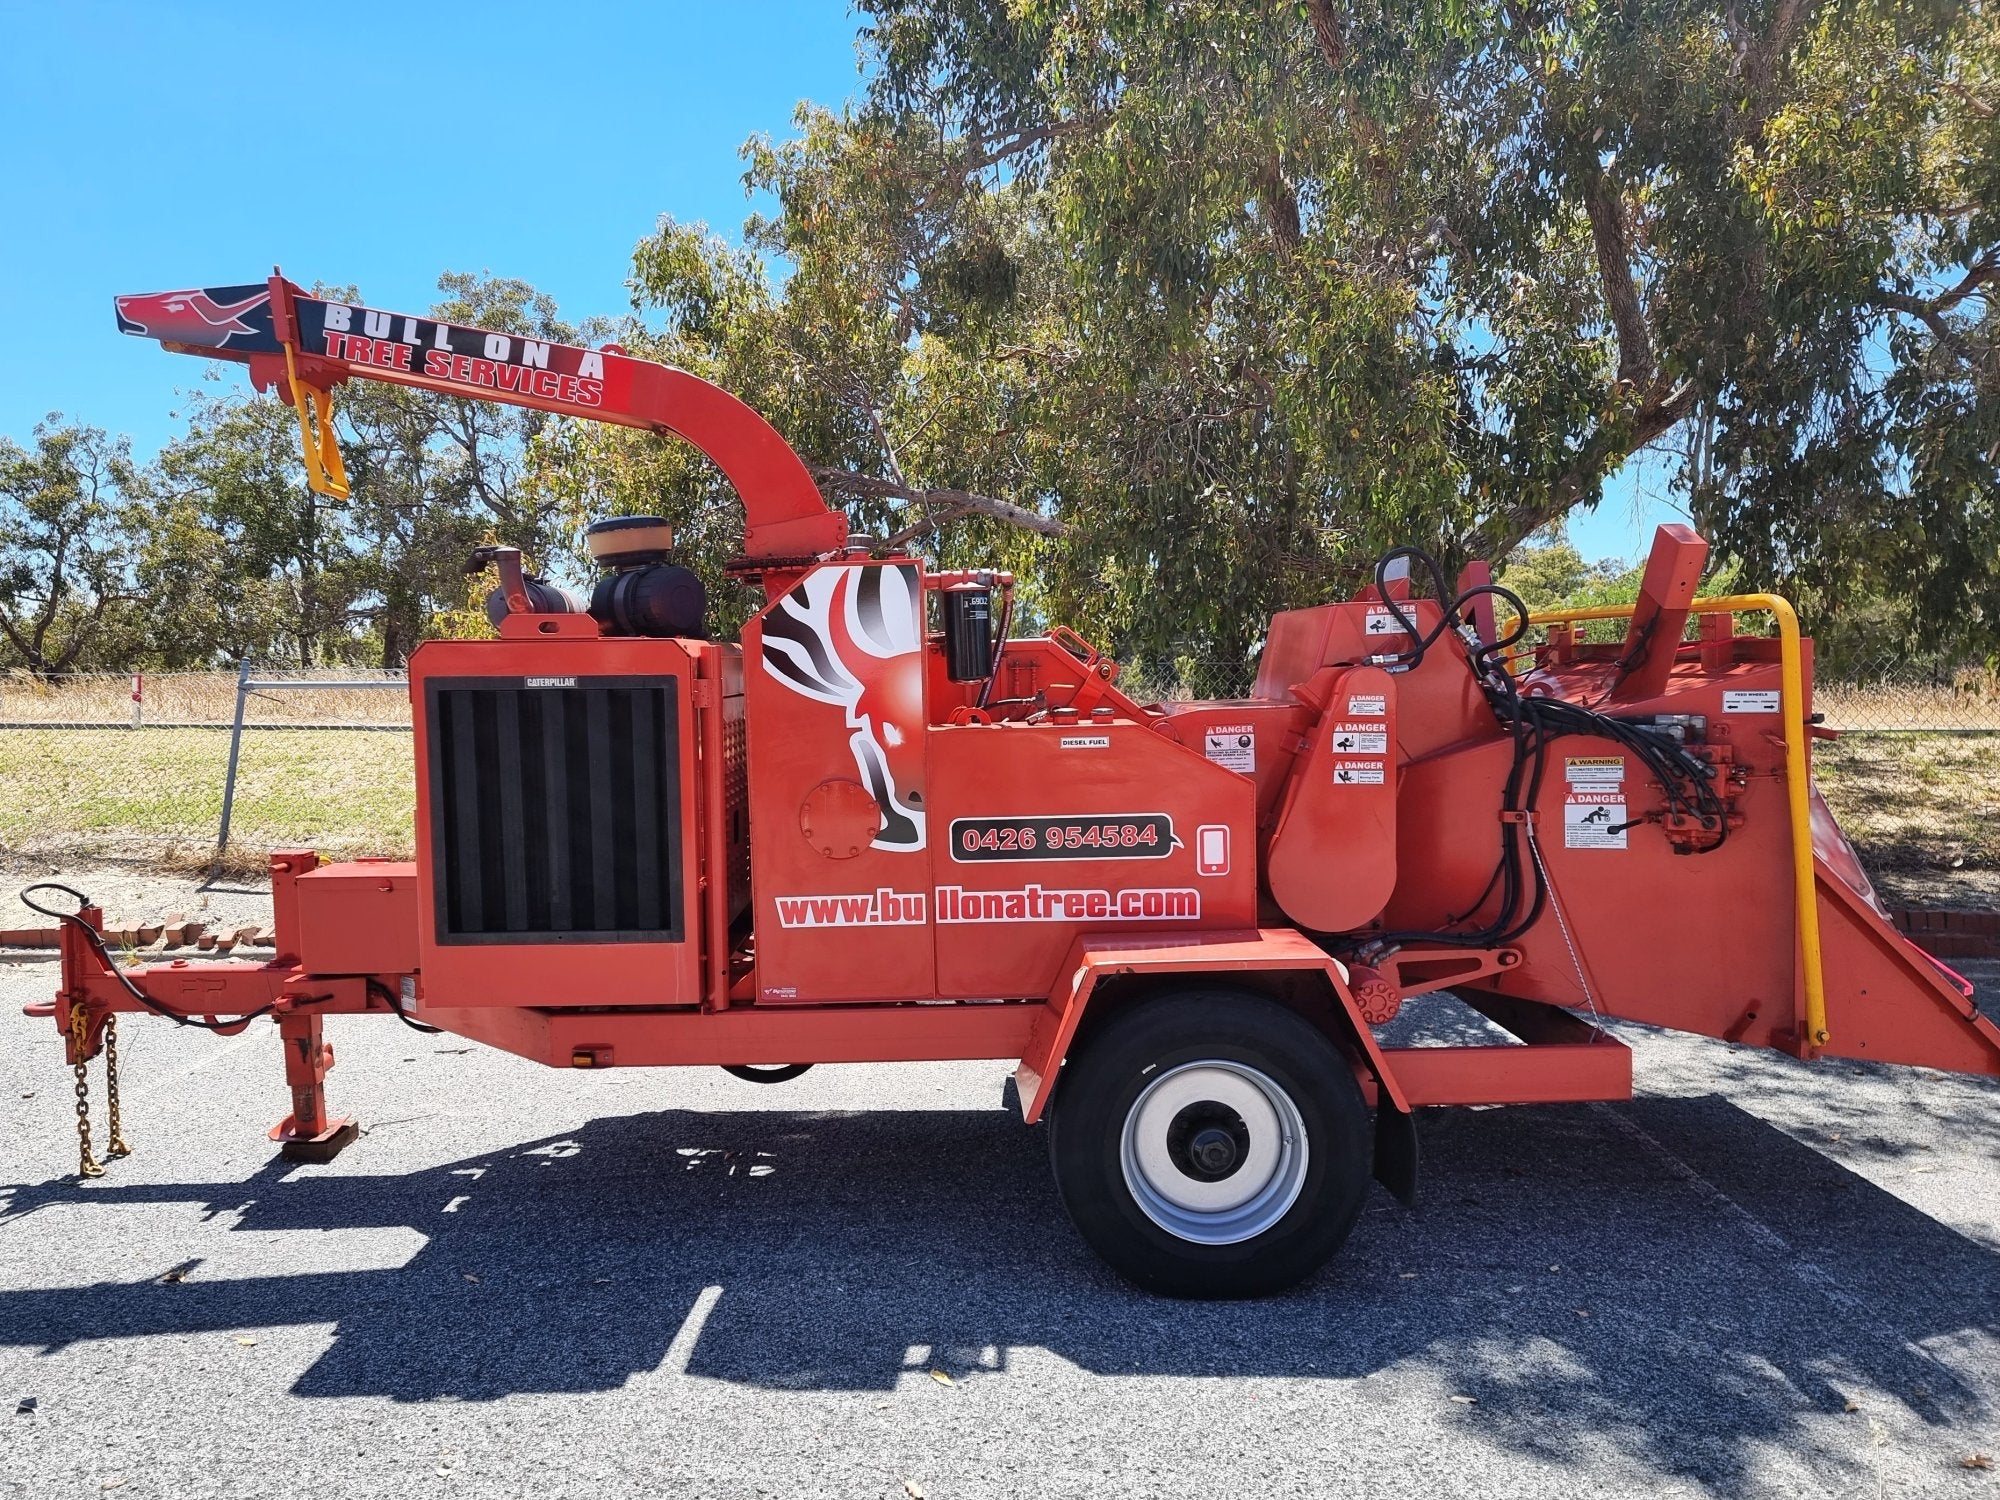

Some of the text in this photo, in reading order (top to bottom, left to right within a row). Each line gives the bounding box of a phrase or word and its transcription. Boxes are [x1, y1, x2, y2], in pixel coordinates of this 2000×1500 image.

[324, 303, 604, 380] BULL ON A
[323, 329, 603, 406] TREE SERVICES
[1376, 605, 1416, 614] DAGER
[527, 678, 575, 687] CATERPILLAR
[1215, 725, 1254, 734] DANGER
[1345, 723, 1386, 732] DANGER
[1344, 761, 1383, 770] DANGER
[1577, 794, 1626, 804] DANGER
[962, 823, 1158, 852] 0426 954584
